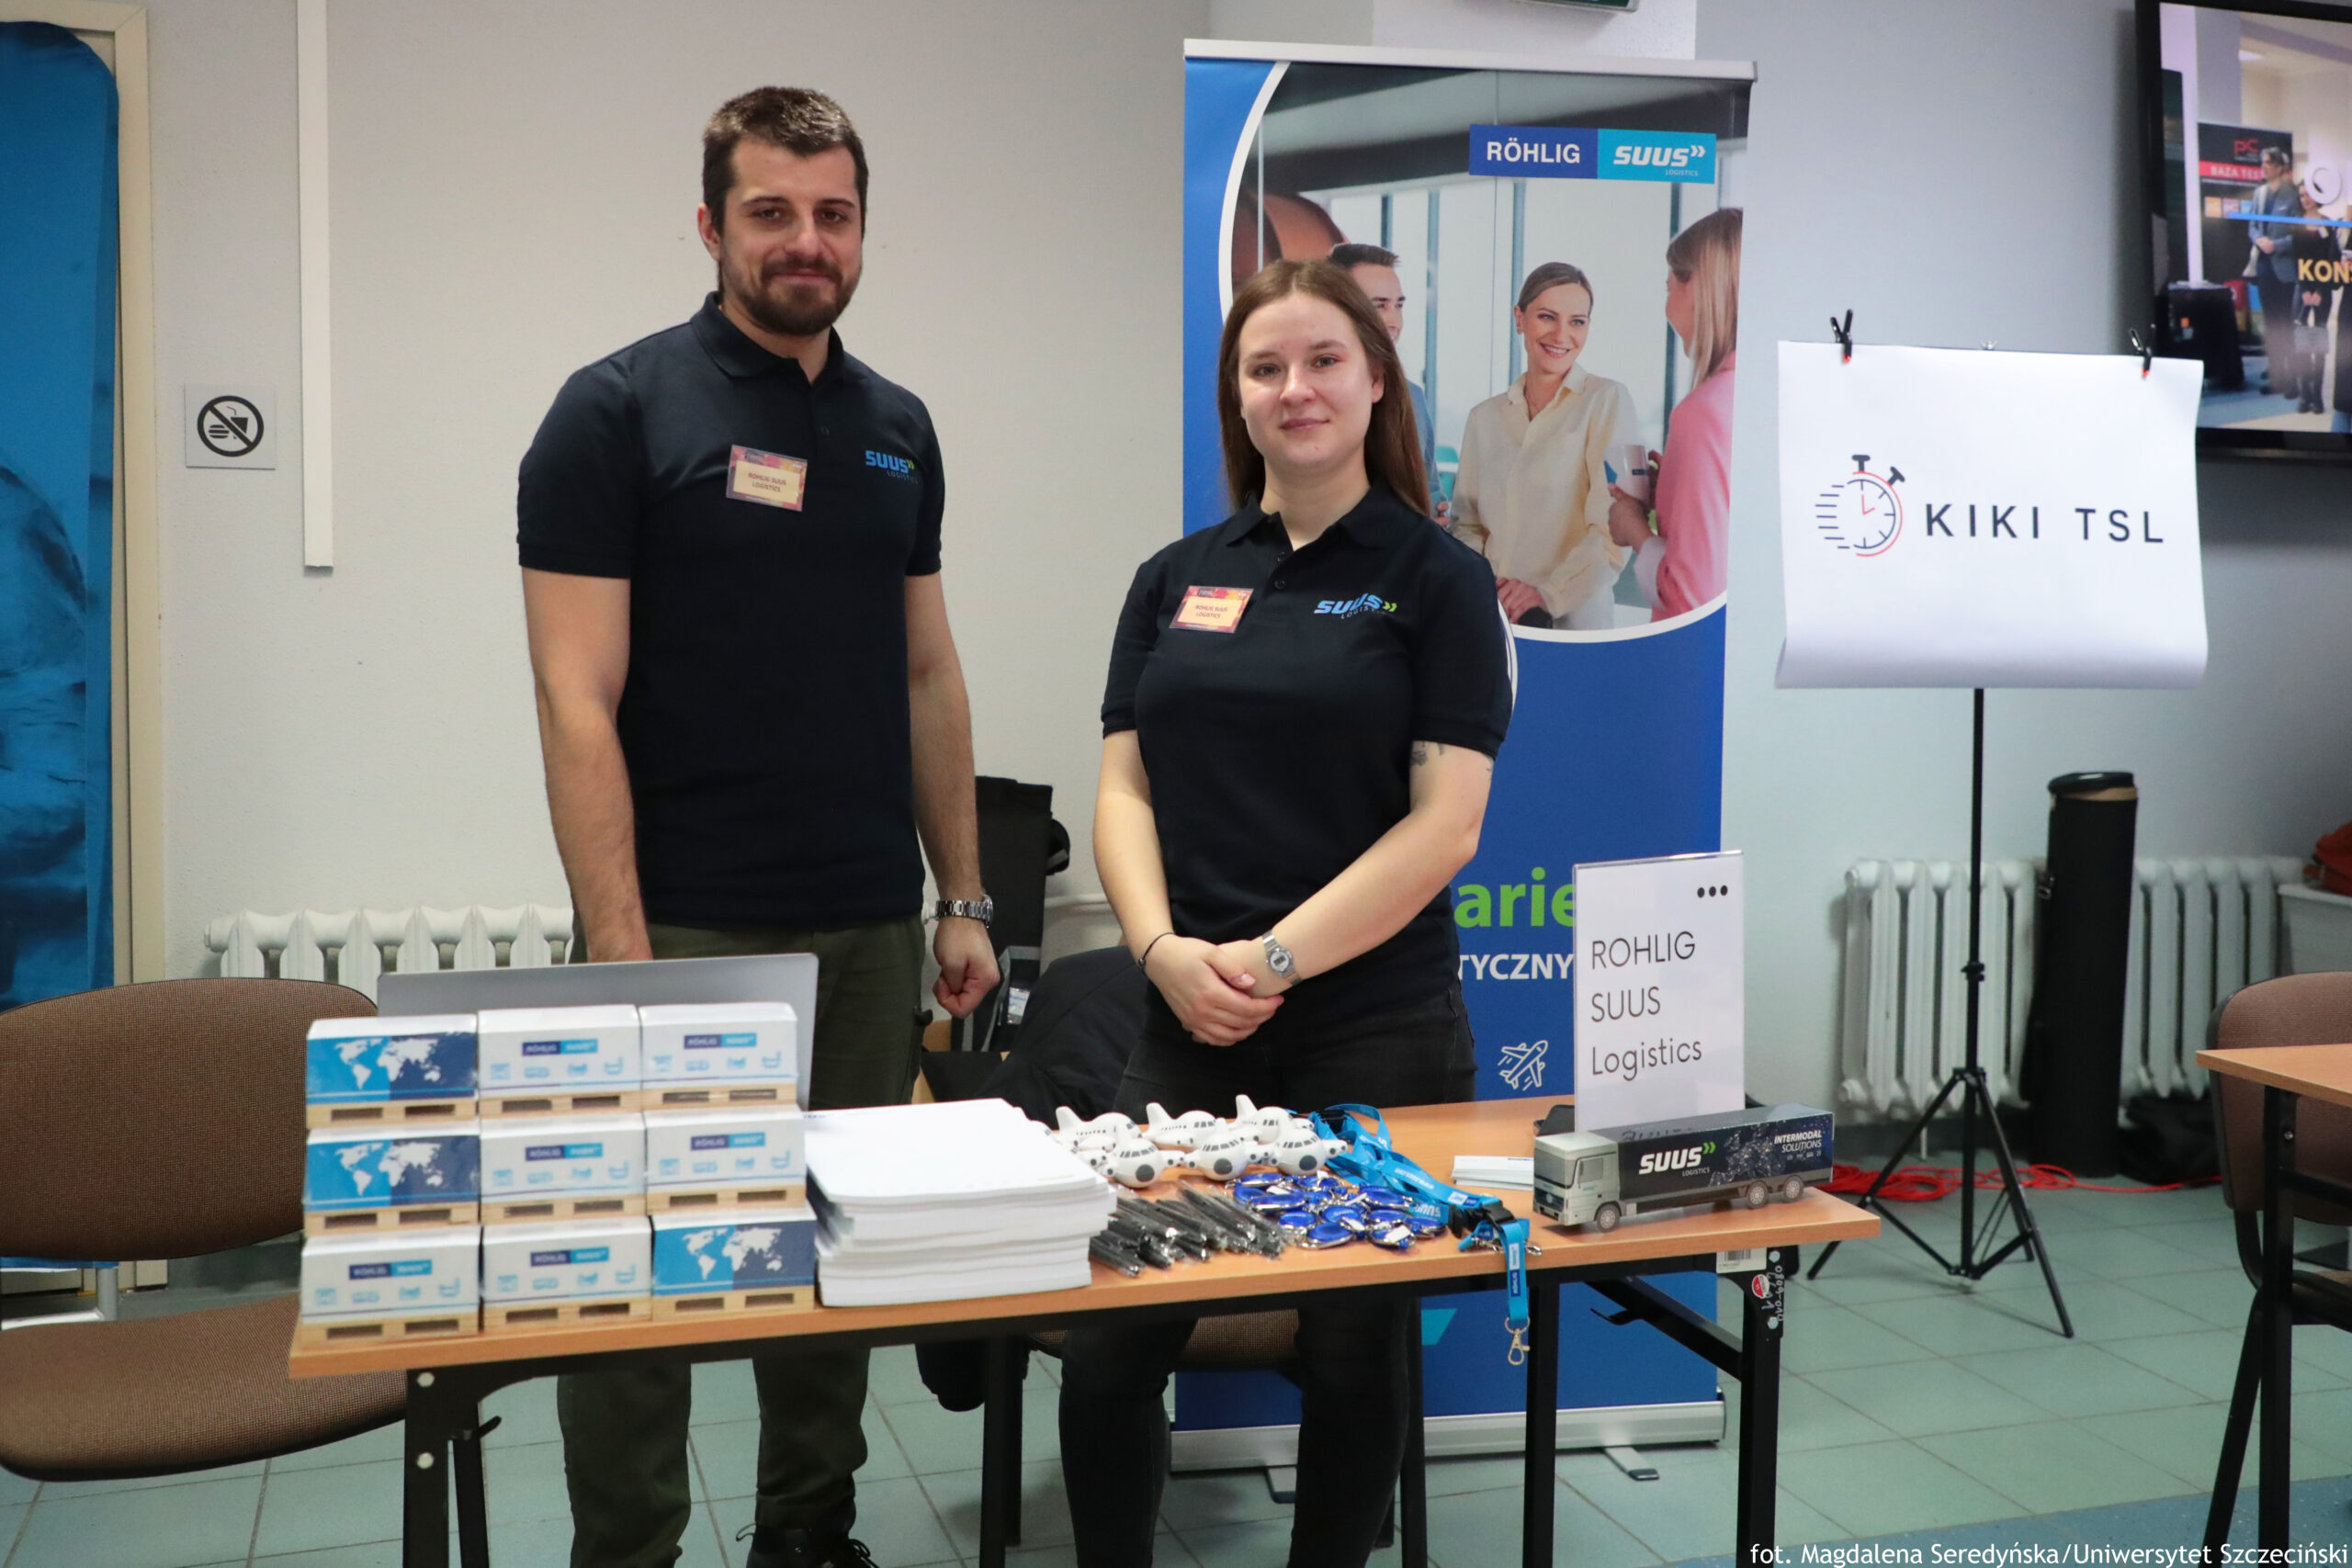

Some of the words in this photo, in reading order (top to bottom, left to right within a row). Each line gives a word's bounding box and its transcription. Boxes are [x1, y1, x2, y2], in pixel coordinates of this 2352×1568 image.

[1487, 137, 1580, 164] RÖHLIG
[1613, 145, 1690, 166] SUUS
[1665, 169, 1699, 177] LOGISTICS
[865, 450, 909, 474] SUUS
[752, 482, 781, 492] LOGISTICS
[1926, 503, 2040, 538] KIKI
[2075, 507, 2164, 543] TSL
[1314, 592, 1384, 615] SUUS
[1591, 931, 1696, 970] ROHLIG
[1591, 986, 1661, 1022] SUUS
[1591, 1037, 1702, 1082] Logistics
[1774, 1130, 1823, 1145] INTERMODAL
[1781, 1139, 1823, 1154] SOLUTIONS
[1639, 1146, 1702, 1175] SUUS
[1681, 1167, 1711, 1177] LOGISTICS
